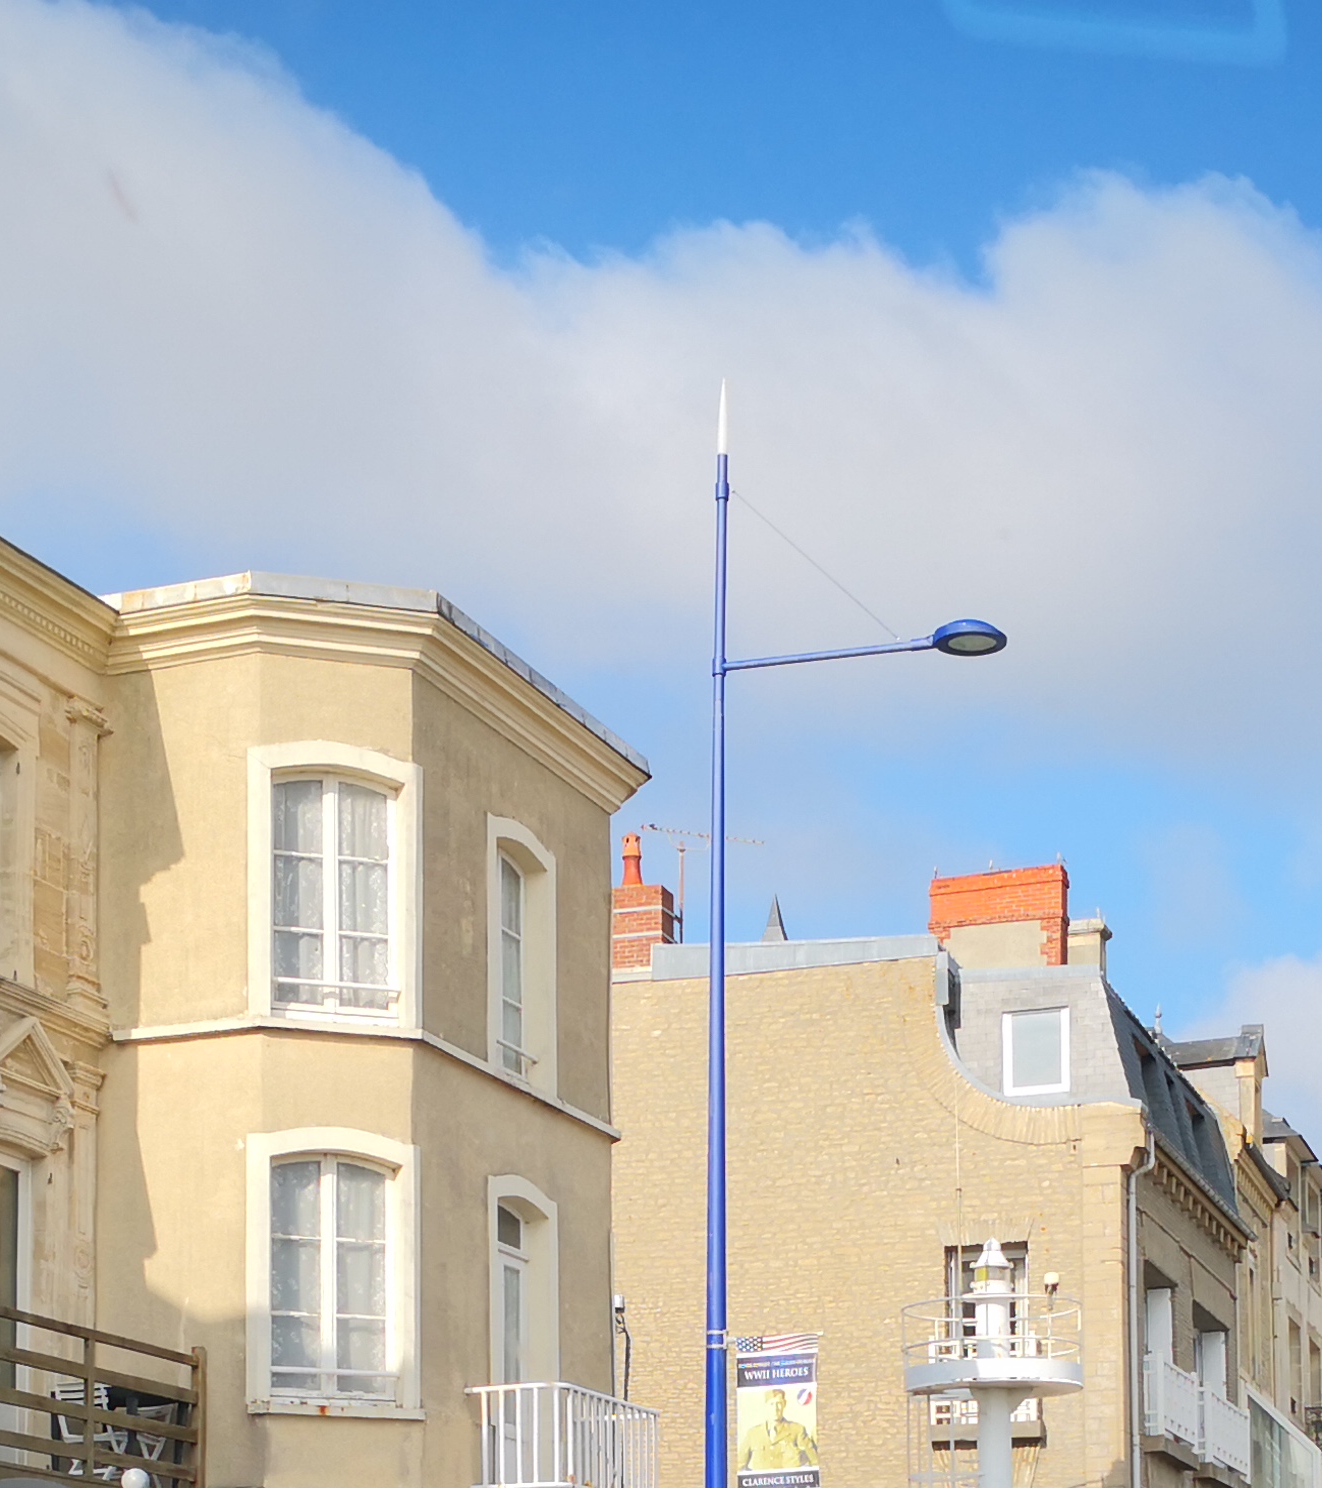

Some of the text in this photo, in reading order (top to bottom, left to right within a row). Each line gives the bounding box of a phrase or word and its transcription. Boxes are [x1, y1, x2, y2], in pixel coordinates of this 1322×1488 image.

[744, 1366, 809, 1380] WWII HEROES
[742, 1473, 814, 1487] CLARENCE STYLES
